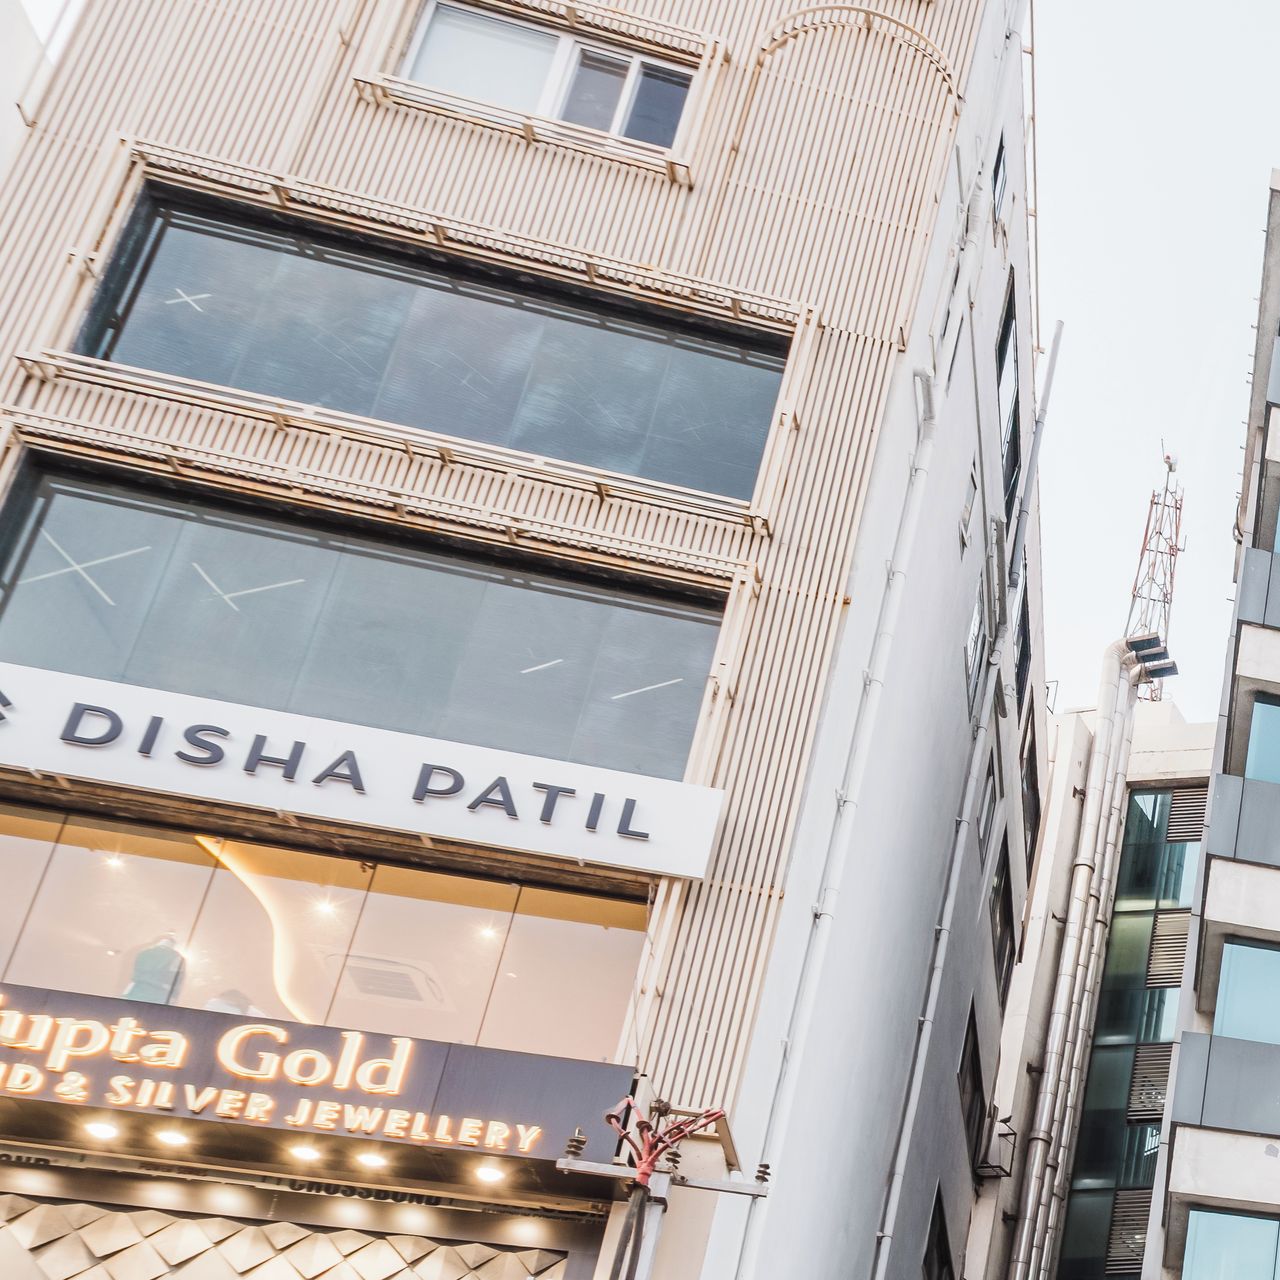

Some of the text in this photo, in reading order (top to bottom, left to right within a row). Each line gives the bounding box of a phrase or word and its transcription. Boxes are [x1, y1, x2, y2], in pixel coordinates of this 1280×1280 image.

[58, 701, 652, 842] DISHA PATIL
[0, 993, 413, 1095] upta Gold
[53, 1070, 89, 1102] &
[104, 1074, 276, 1122] SILVER
[284, 1097, 543, 1152] JEWELLERY
